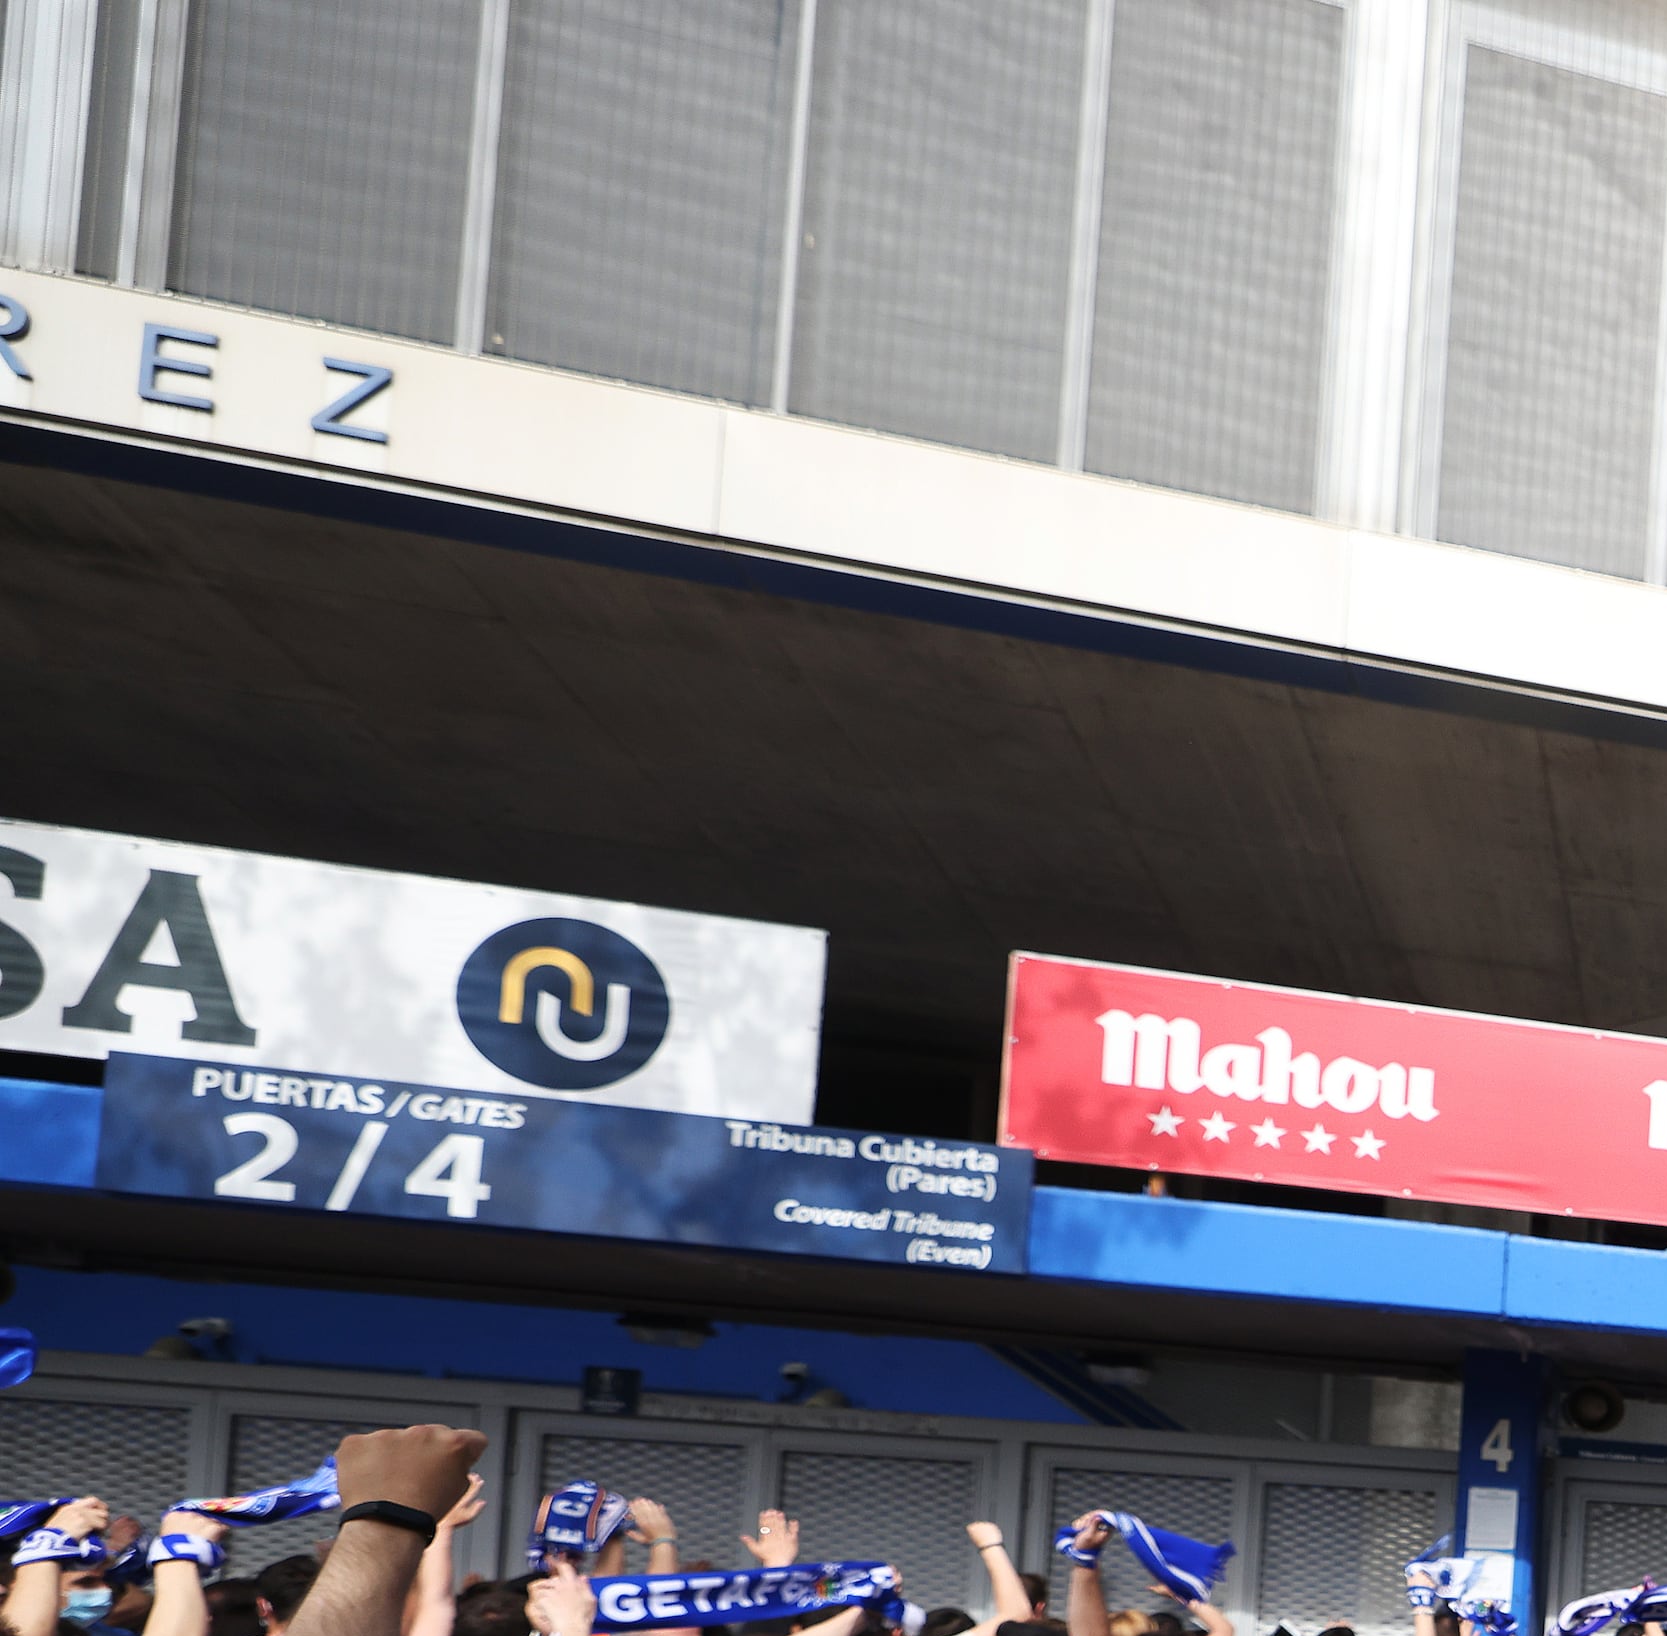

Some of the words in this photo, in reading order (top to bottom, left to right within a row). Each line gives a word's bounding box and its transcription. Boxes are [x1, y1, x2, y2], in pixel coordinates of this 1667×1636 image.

[1095, 1008, 1441, 1123] Mahou
[214, 1111, 299, 1203] 2
[403, 1134, 492, 1218] 4
[724, 1119, 856, 1161] Tribuna
[858, 1135, 1000, 1174] Cubierta
[886, 1163, 998, 1203] (Pares)
[773, 1198, 889, 1233] Covered
[892, 1209, 995, 1243] Tribune
[906, 1237, 993, 1271] (Even)
[1479, 1418, 1515, 1473] 4
